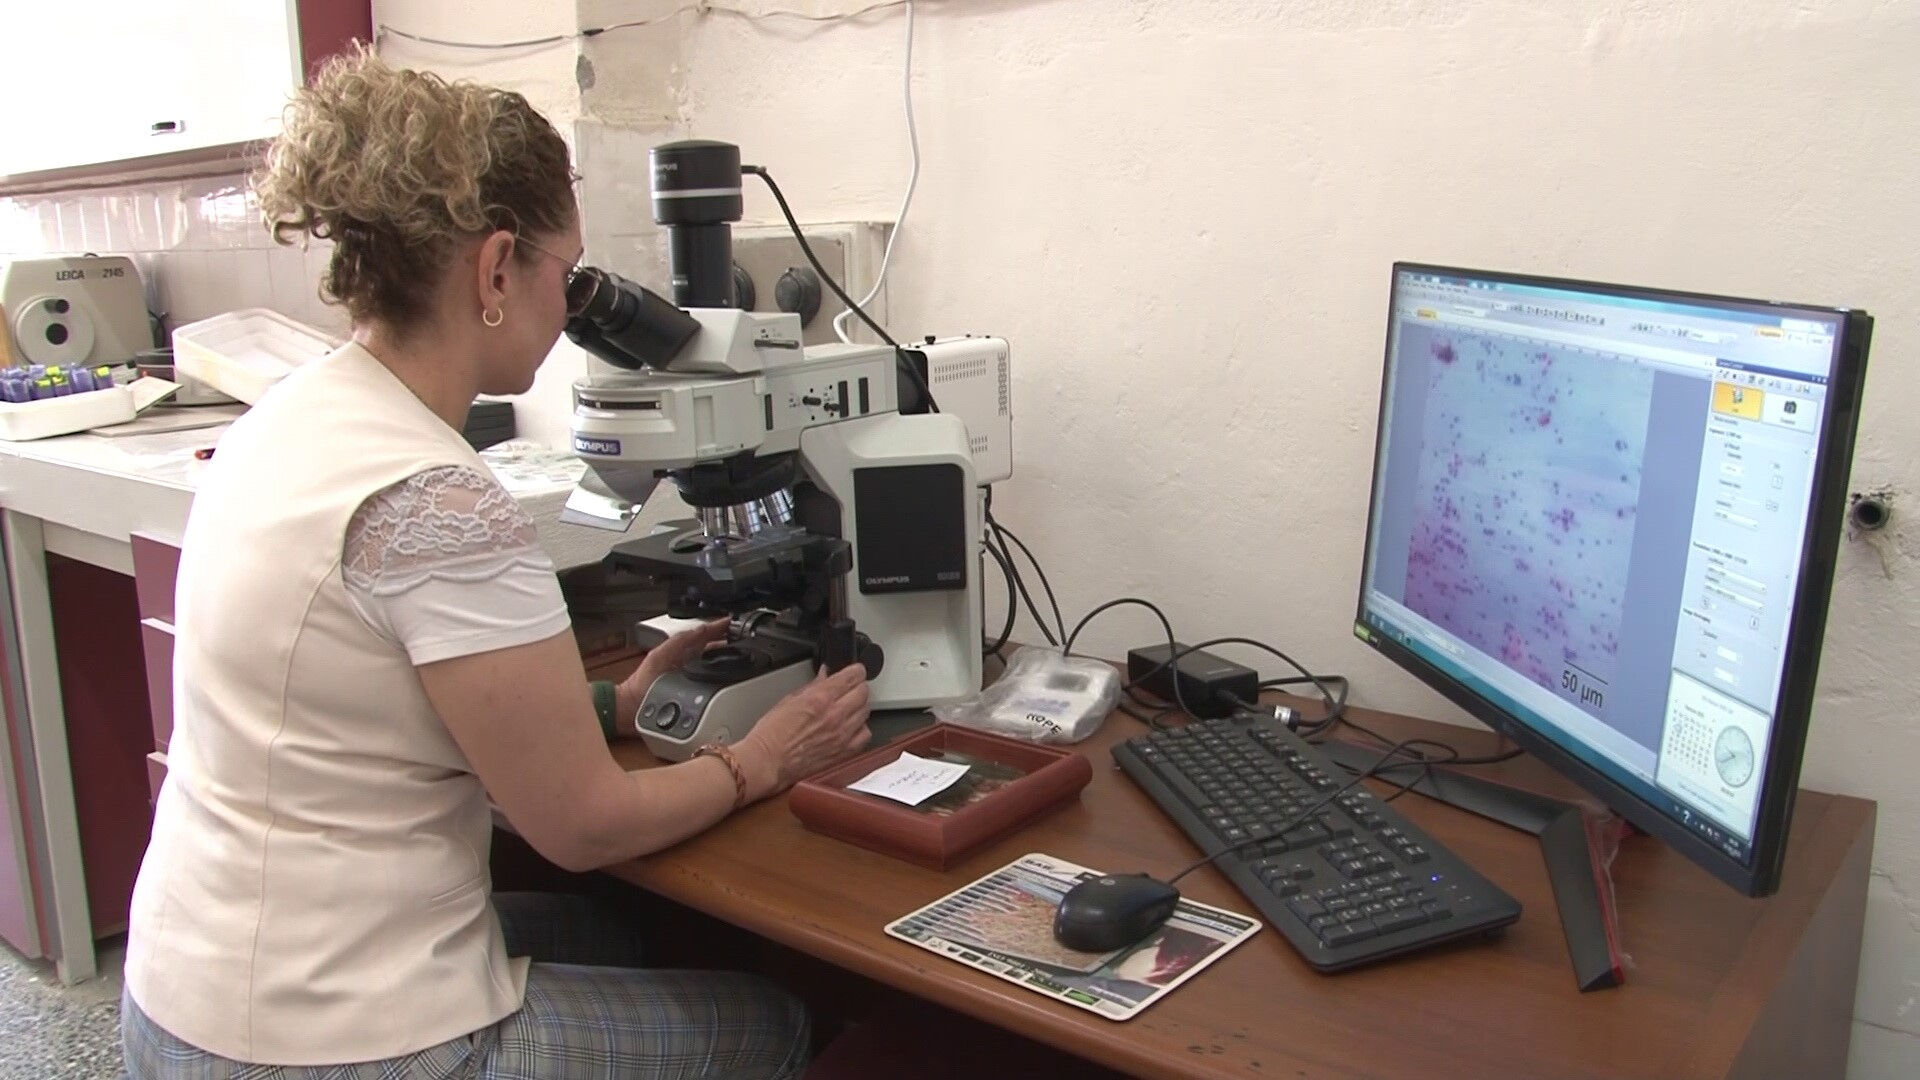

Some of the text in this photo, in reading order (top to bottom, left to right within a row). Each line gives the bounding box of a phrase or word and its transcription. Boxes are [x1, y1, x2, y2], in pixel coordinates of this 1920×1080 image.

[56, 270, 85, 281] LEICA
[865, 575, 910, 586] OLYMPUS
[1561, 669, 1578, 693] 50
